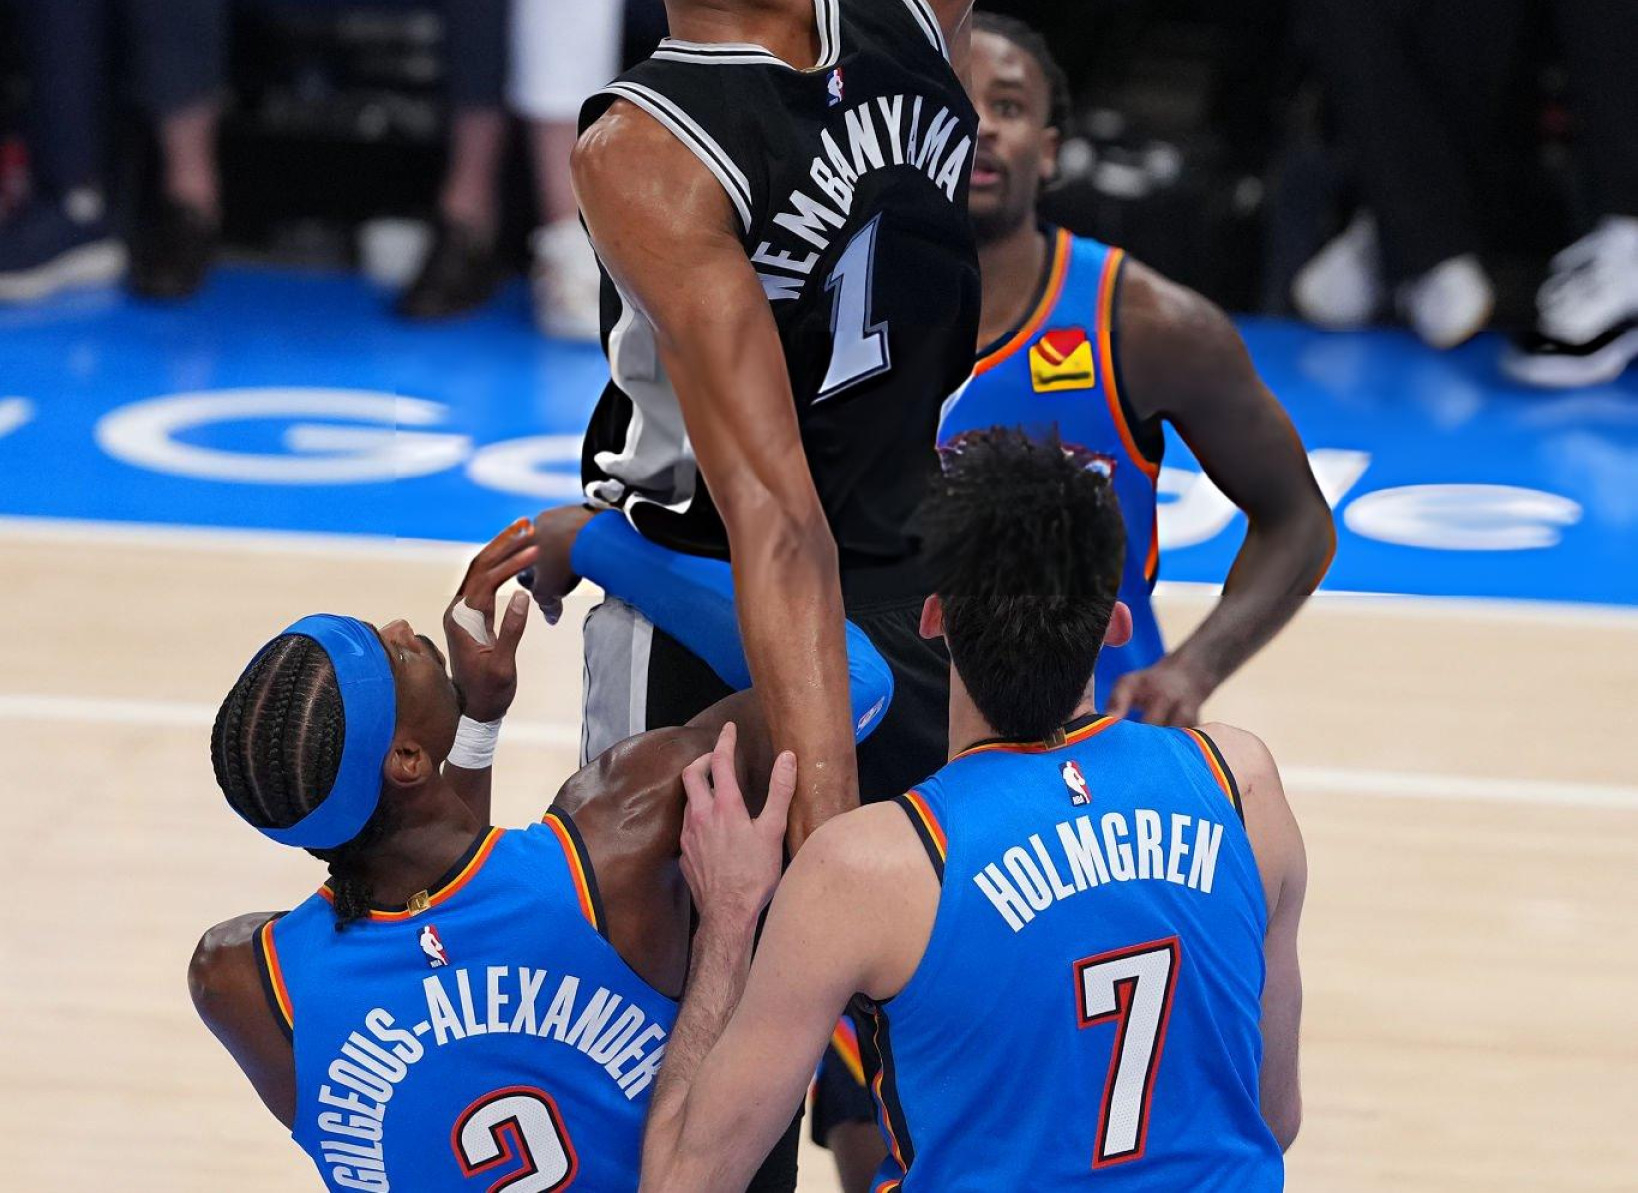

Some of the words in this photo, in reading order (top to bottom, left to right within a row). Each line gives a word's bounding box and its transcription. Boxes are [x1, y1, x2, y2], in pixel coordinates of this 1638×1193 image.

[811, 211, 892, 405] 1
[972, 808, 1224, 933] HOLMGREN
[317, 965, 668, 1193] GILGEOUS-ALEXANDER
[1072, 934, 1182, 1170] 7
